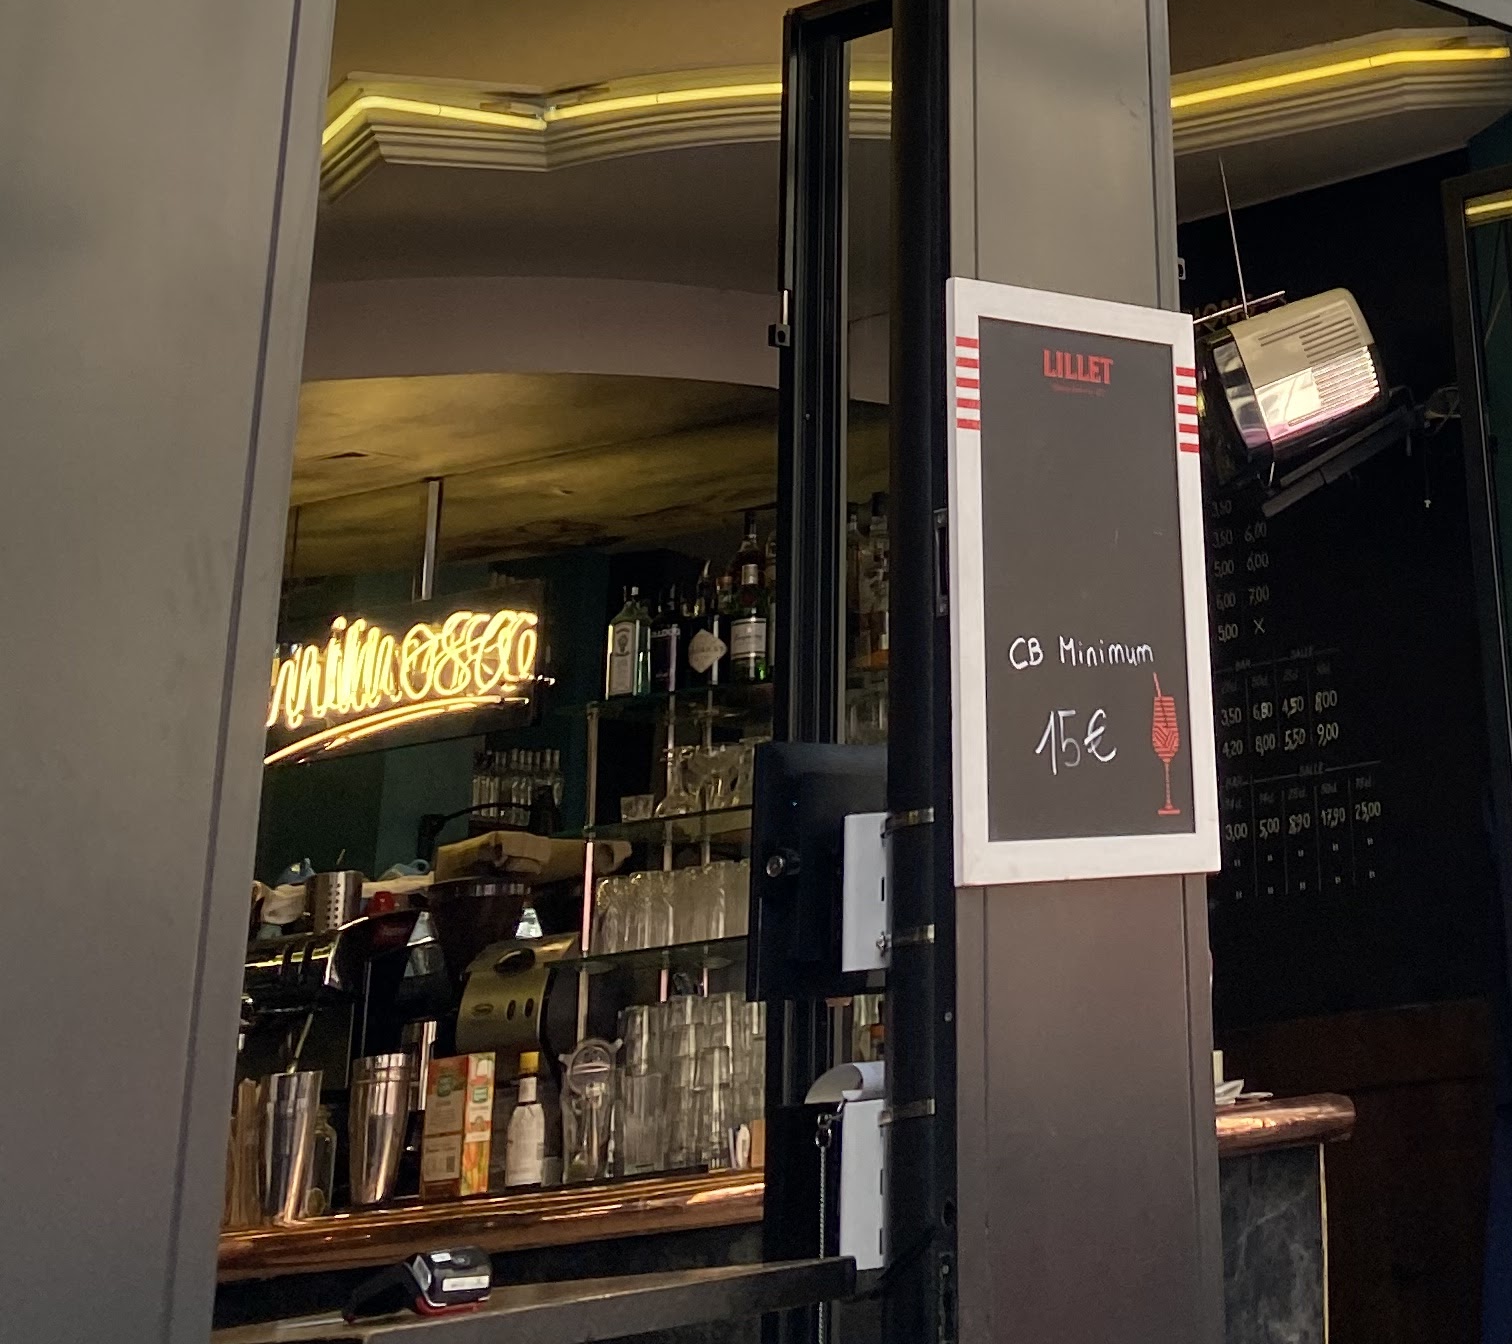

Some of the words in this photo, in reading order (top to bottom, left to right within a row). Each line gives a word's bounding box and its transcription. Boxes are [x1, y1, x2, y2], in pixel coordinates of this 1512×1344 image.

[1043, 349, 1114, 385] LILLET
[266, 610, 540, 729] mimosa
[1009, 636, 1044, 670] CB
[1059, 635, 1154, 667] Minimum
[1035, 708, 1117, 776] 15€
[1317, 722, 1339, 747] 9,00
[1225, 822, 1248, 843] 3,00
[1259, 817, 1280, 840] 5,00
